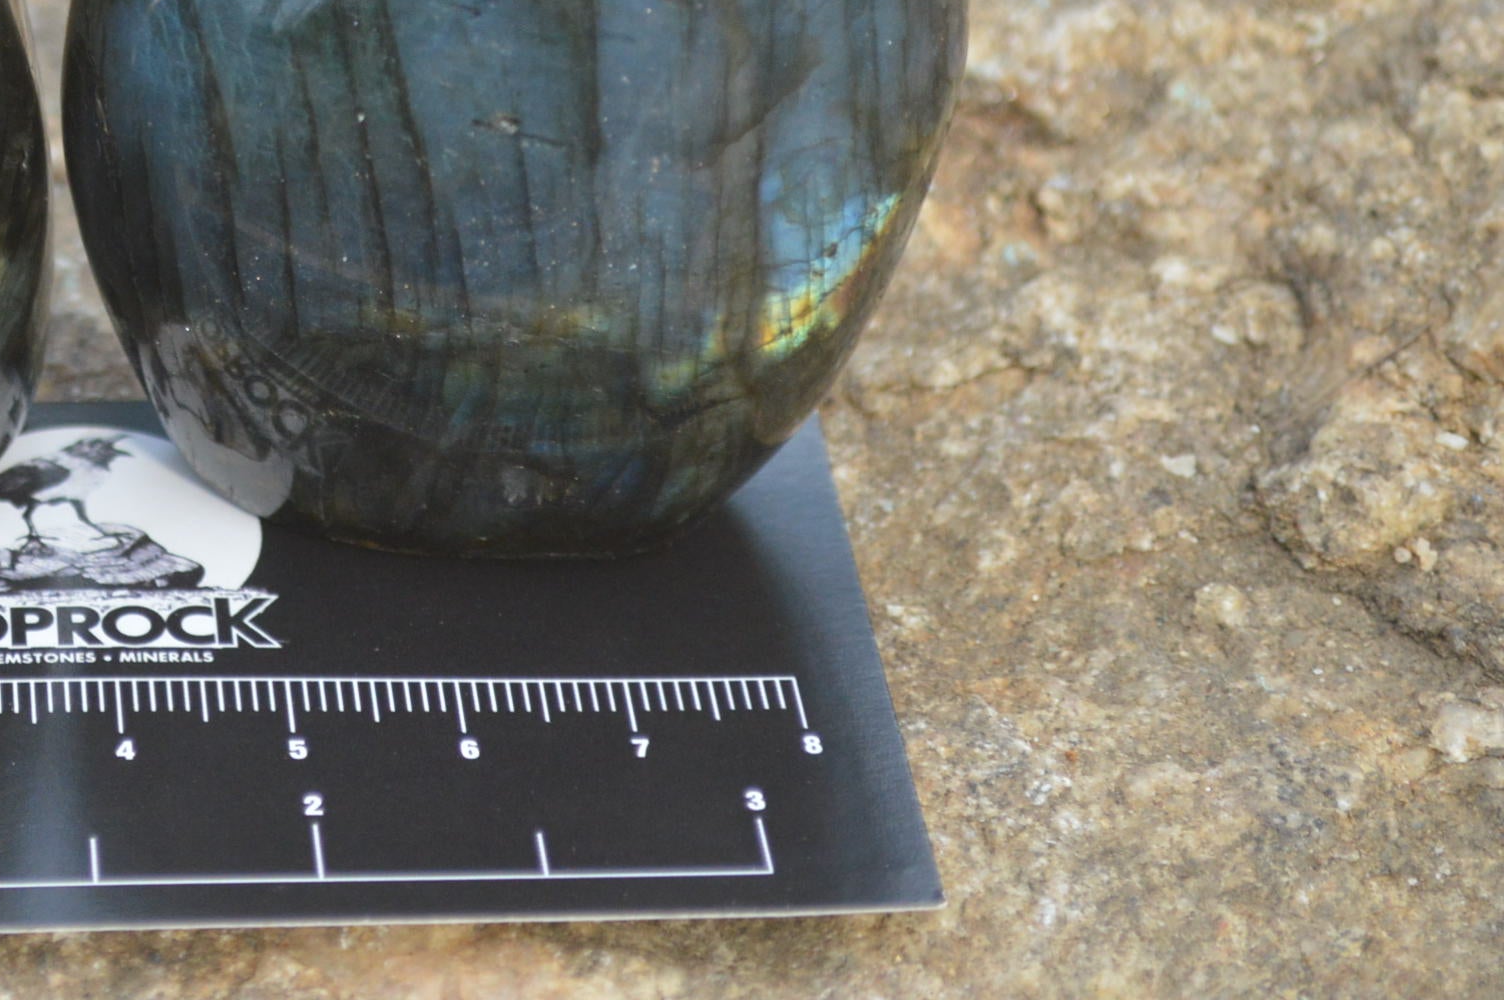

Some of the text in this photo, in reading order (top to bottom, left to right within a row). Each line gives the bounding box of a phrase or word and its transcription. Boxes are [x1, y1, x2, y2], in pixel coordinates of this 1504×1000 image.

[119, 650, 215, 664] MINERALS
[115, 739, 136, 760] 4
[288, 738, 308, 759] 5
[460, 738, 480, 759] 6
[631, 737, 649, 758] 7
[802, 734, 823, 754] 8
[303, 793, 324, 816] 2
[745, 789, 766, 811] 3
